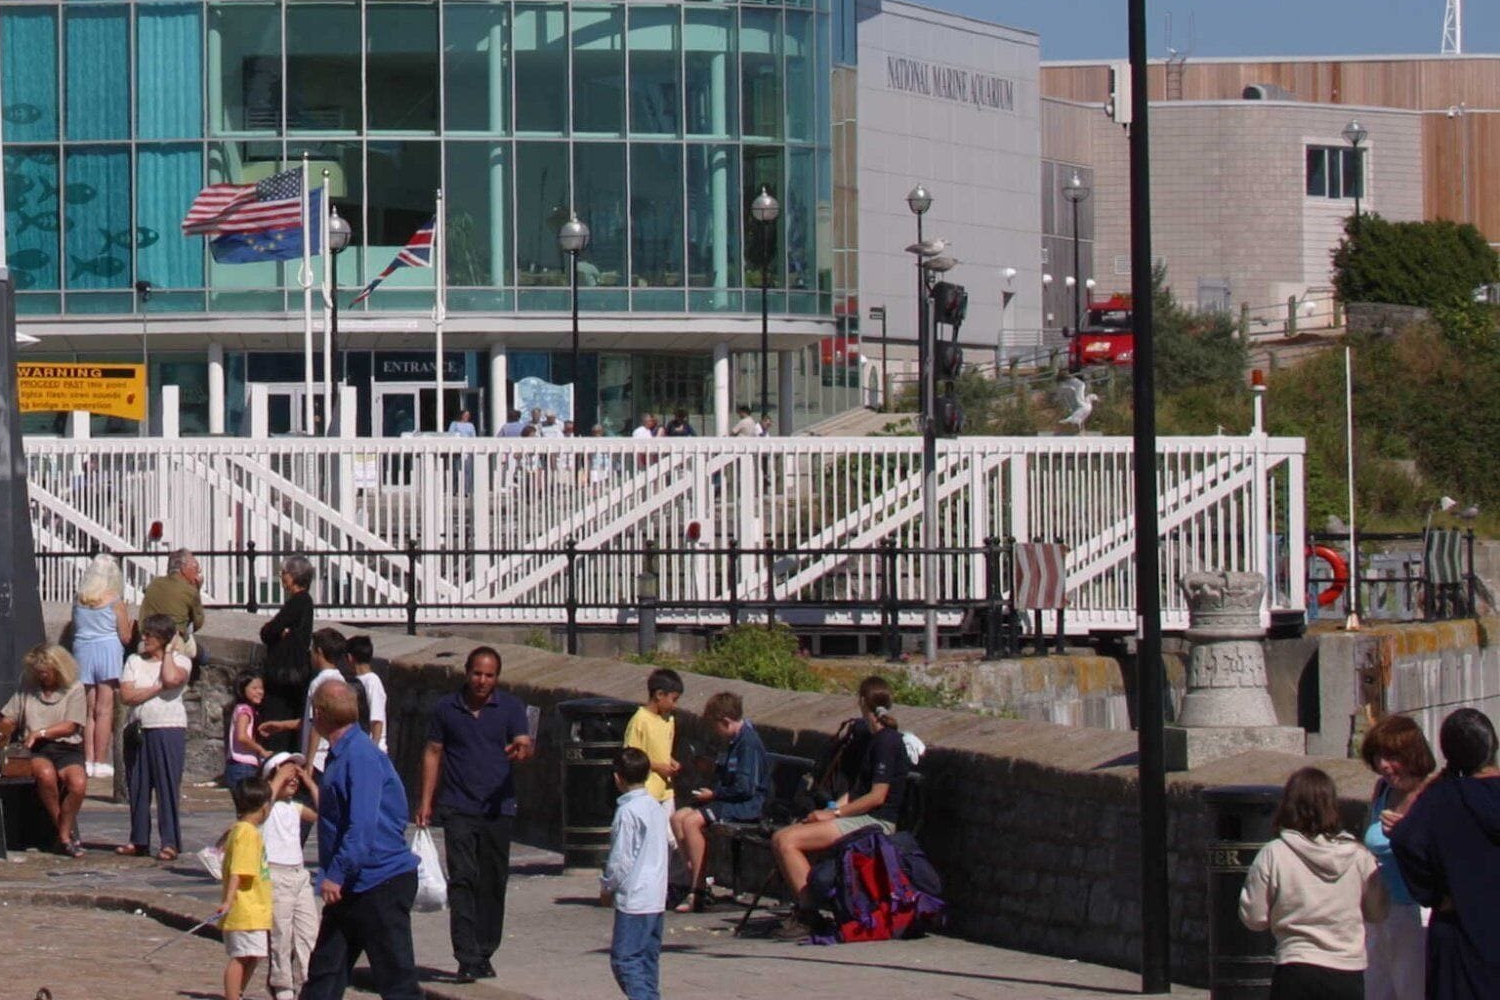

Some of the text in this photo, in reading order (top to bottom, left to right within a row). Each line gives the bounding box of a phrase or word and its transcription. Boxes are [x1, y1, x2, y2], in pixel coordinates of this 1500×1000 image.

[886, 56, 1014, 111] NATIONAL MARINE AQUARIUM
[17, 367, 102, 378] WARNING
[63, 380, 84, 389] PAST
